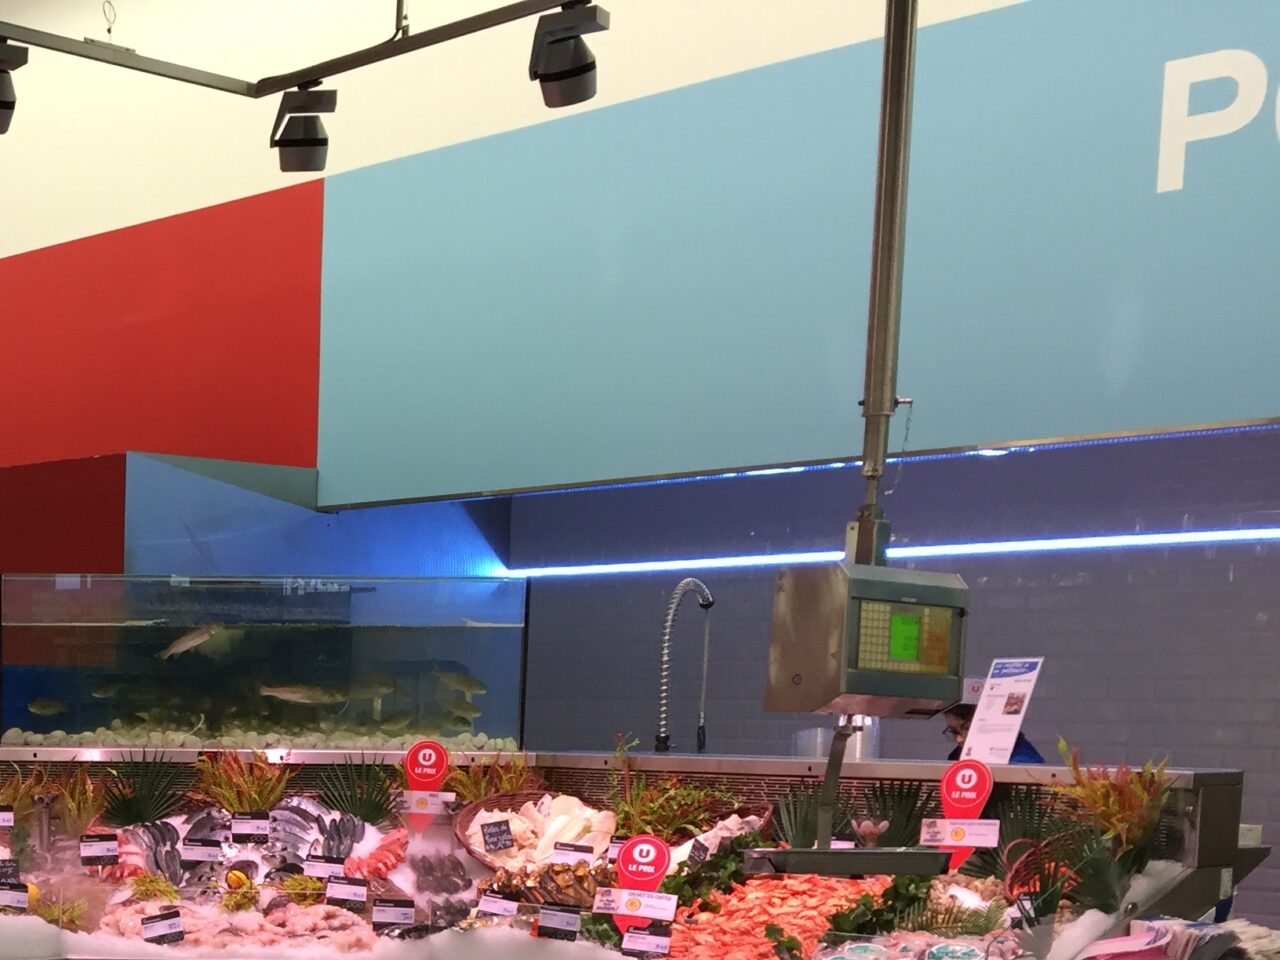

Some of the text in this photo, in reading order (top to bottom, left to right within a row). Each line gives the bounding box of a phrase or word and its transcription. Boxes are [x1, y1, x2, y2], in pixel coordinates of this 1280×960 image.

[1156, 48, 1280, 193] P
[423, 767, 437, 775] PRIX
[951, 791, 977, 799] LE PRIX
[638, 865, 655, 873] PRIX
